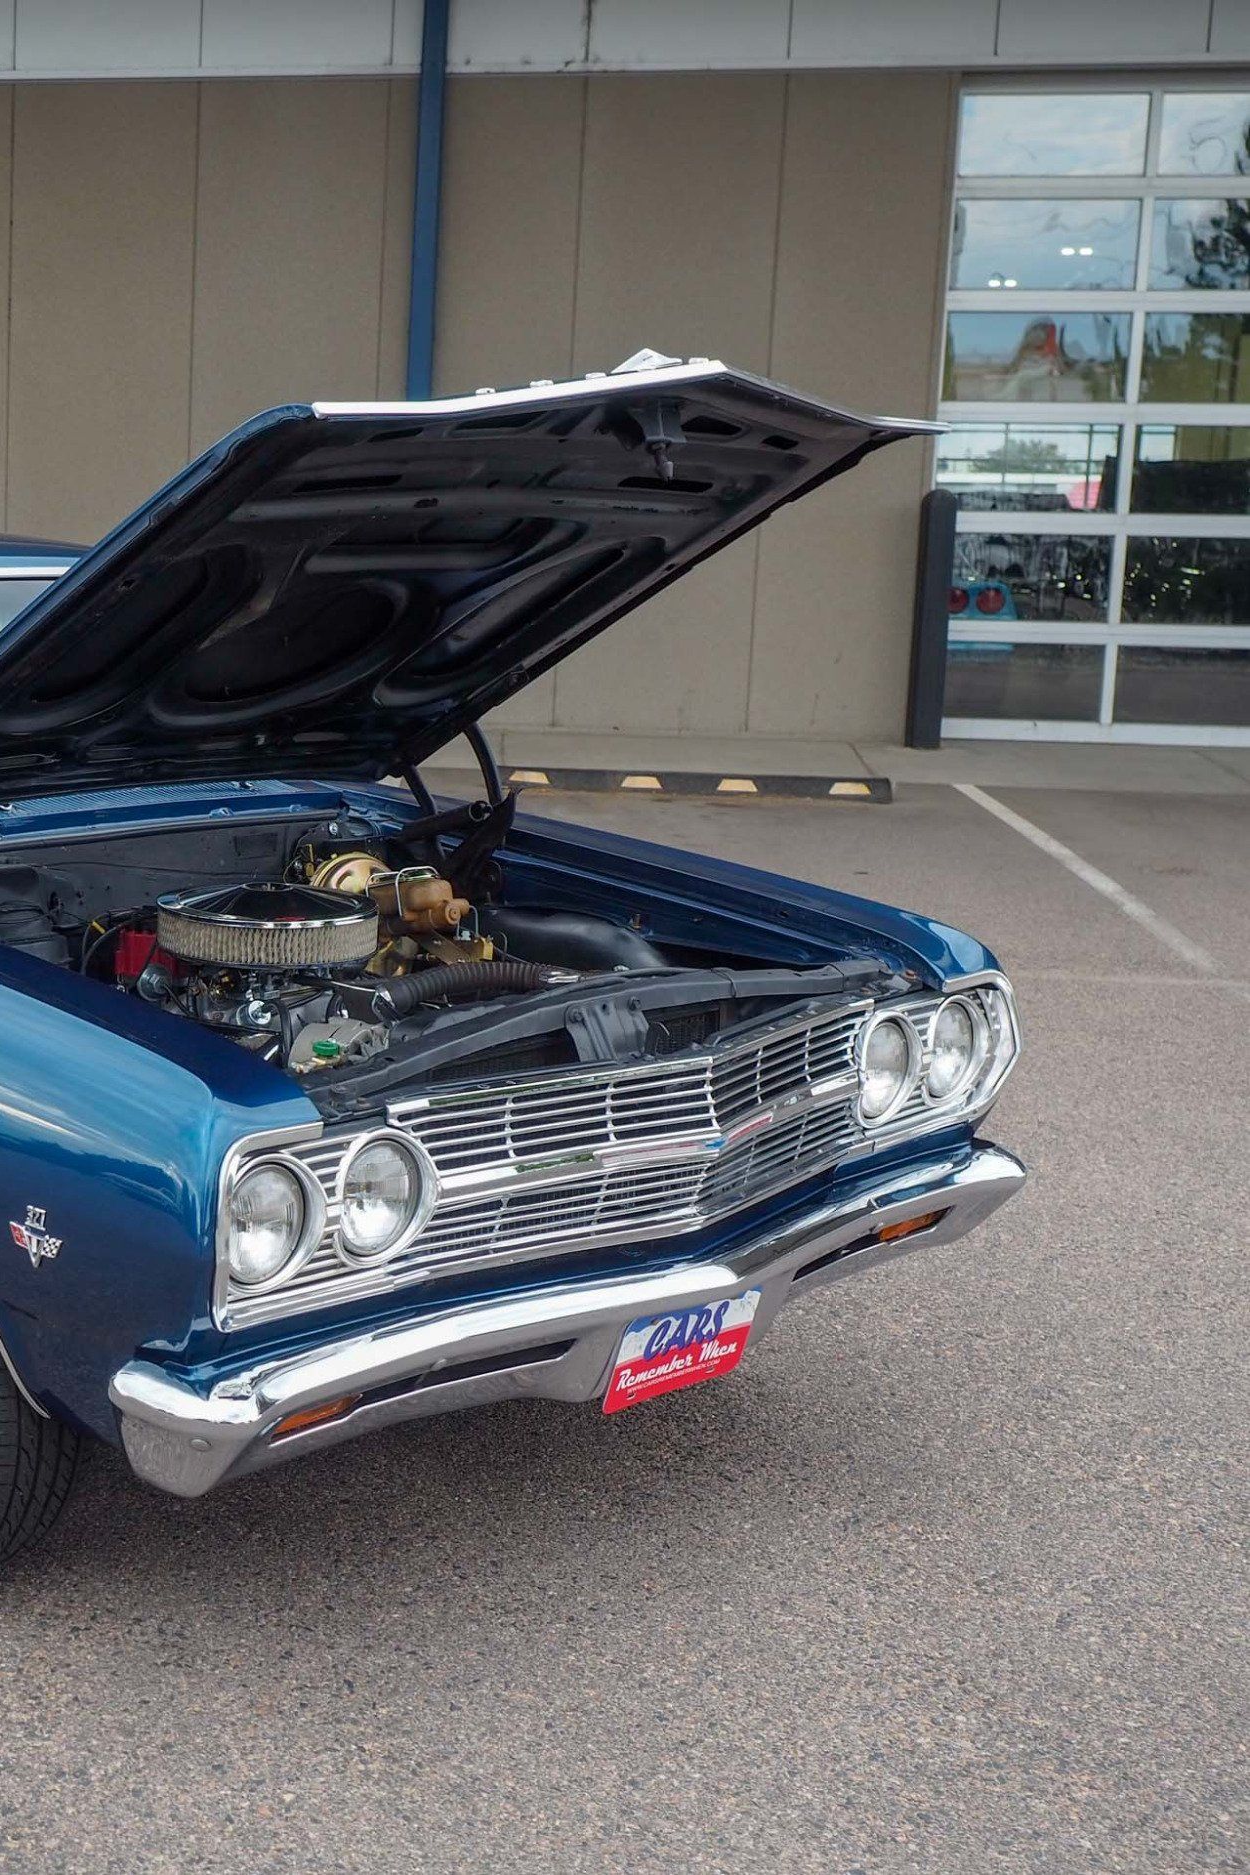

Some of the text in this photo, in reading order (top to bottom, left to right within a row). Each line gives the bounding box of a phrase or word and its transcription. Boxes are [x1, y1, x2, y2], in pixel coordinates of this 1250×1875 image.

[643, 1300, 730, 1361] CARS
[616, 1340, 738, 1391] Remember When
